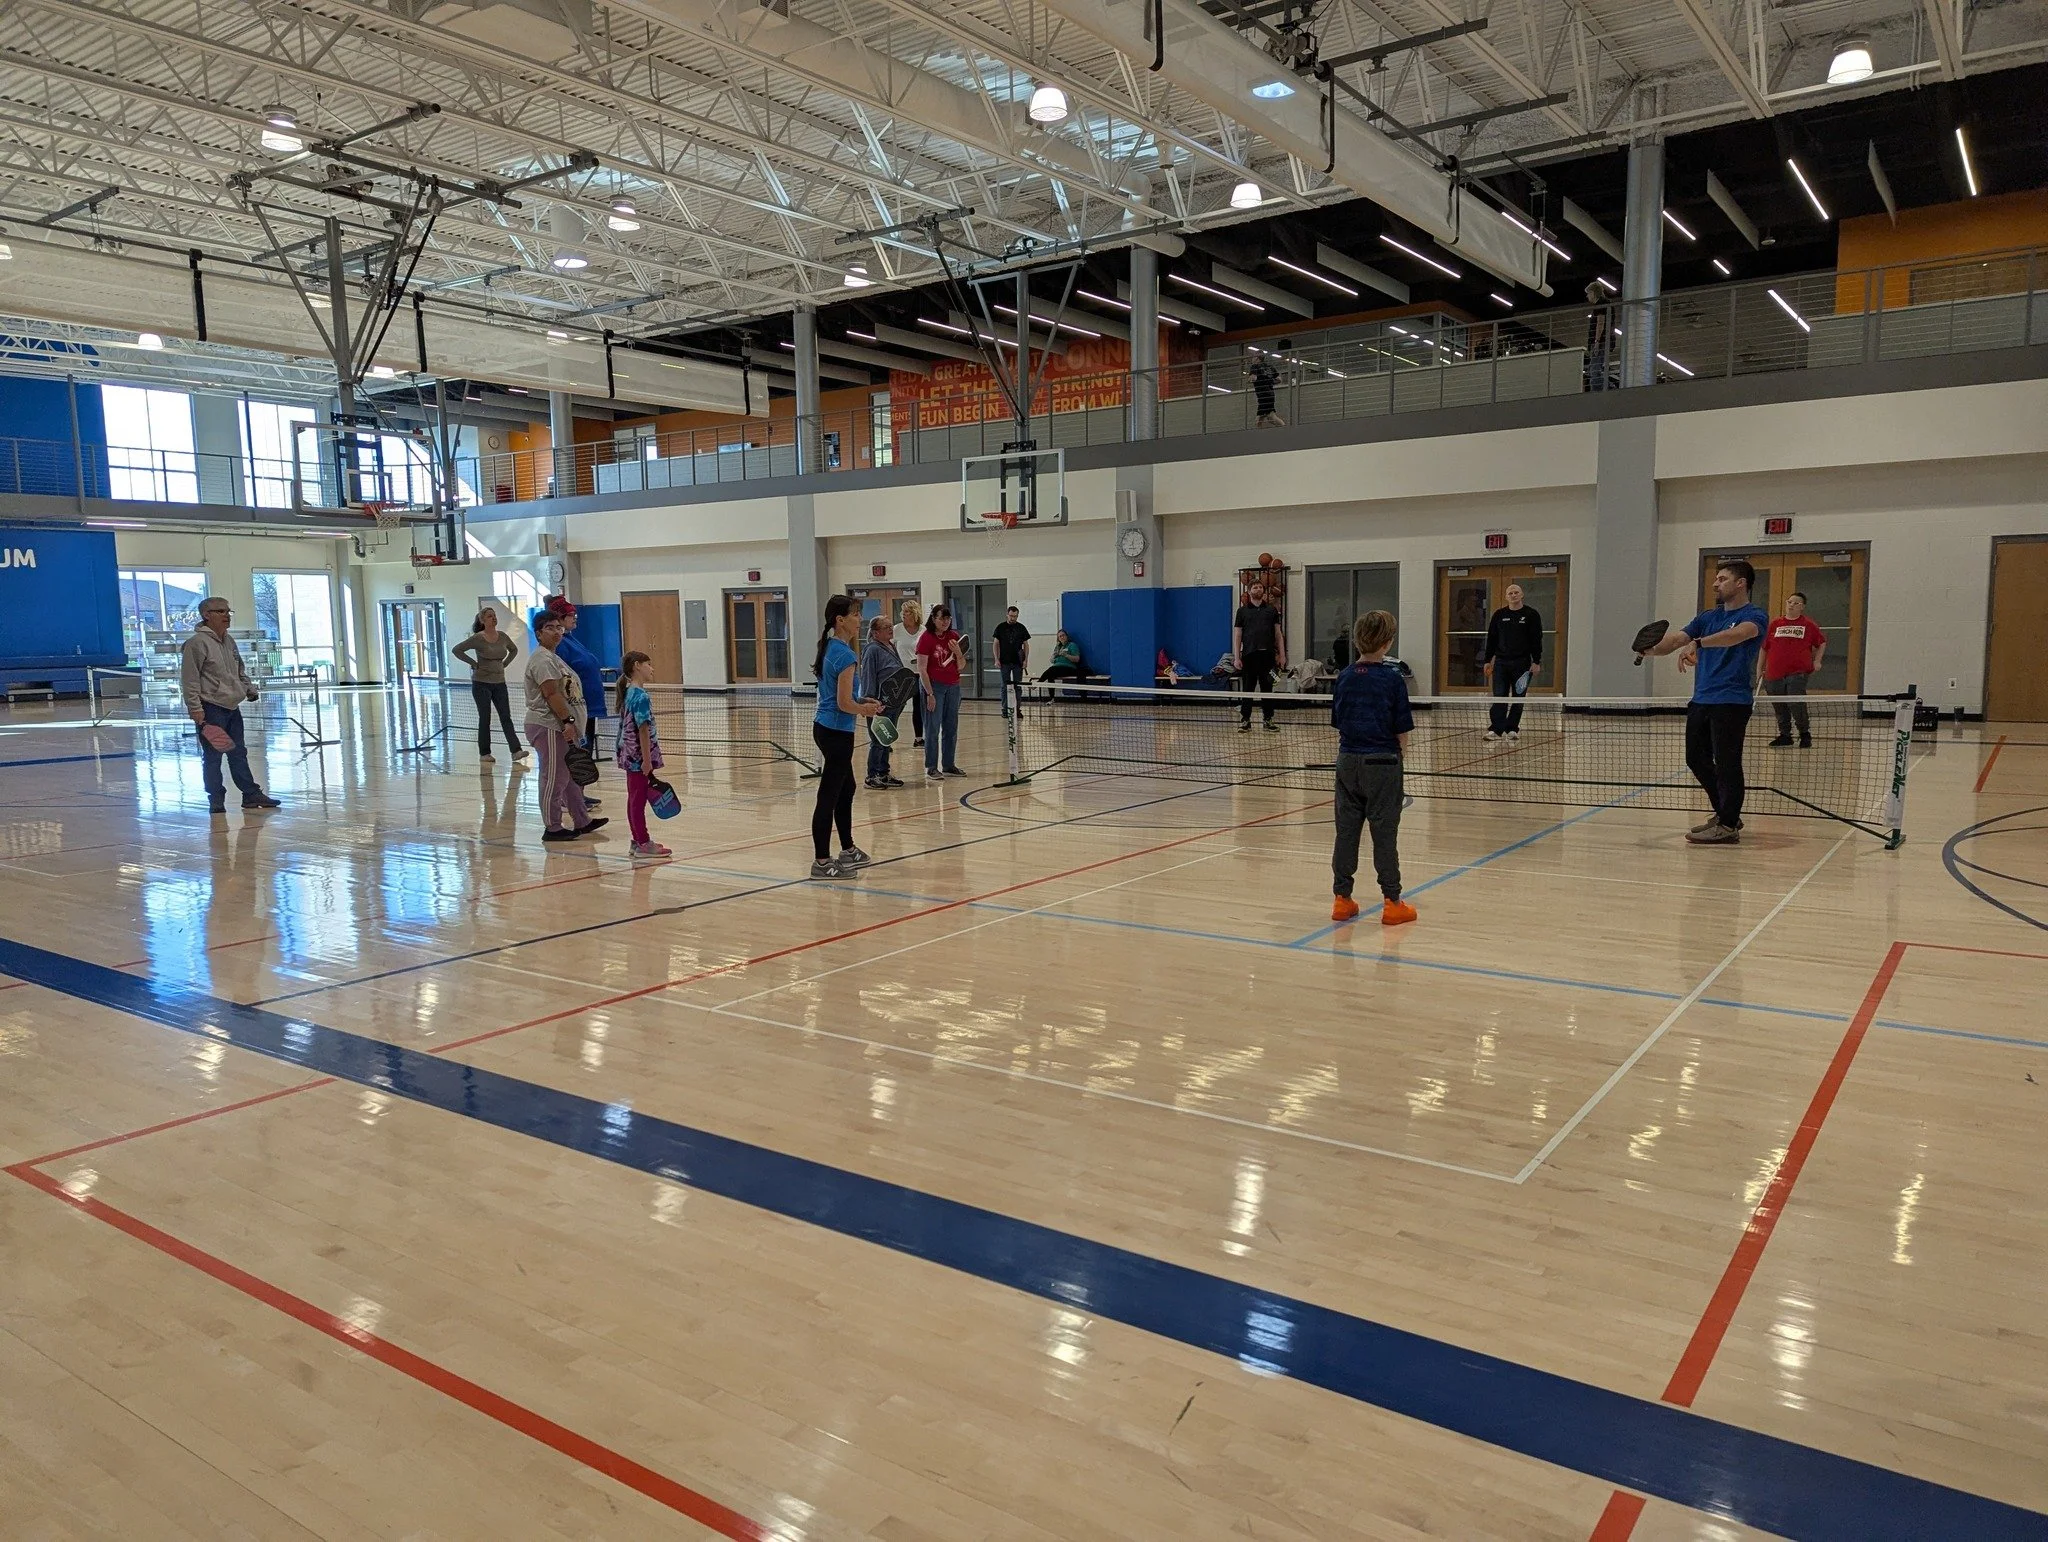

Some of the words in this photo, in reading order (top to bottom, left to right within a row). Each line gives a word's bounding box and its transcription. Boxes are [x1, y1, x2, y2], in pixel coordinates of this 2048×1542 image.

[1053, 340, 1131, 372] CONN
[935, 362, 991, 381] GREATE
[920, 384, 954, 408] LET
[960, 379, 1001, 403] THE
[1053, 395, 1096, 413] FROM
[919, 408, 949, 427] FUN
[953, 402, 1000, 423] BEGIN
[1768, 519, 1788, 534] EXIT
[1488, 535, 1505, 549] EXIT
